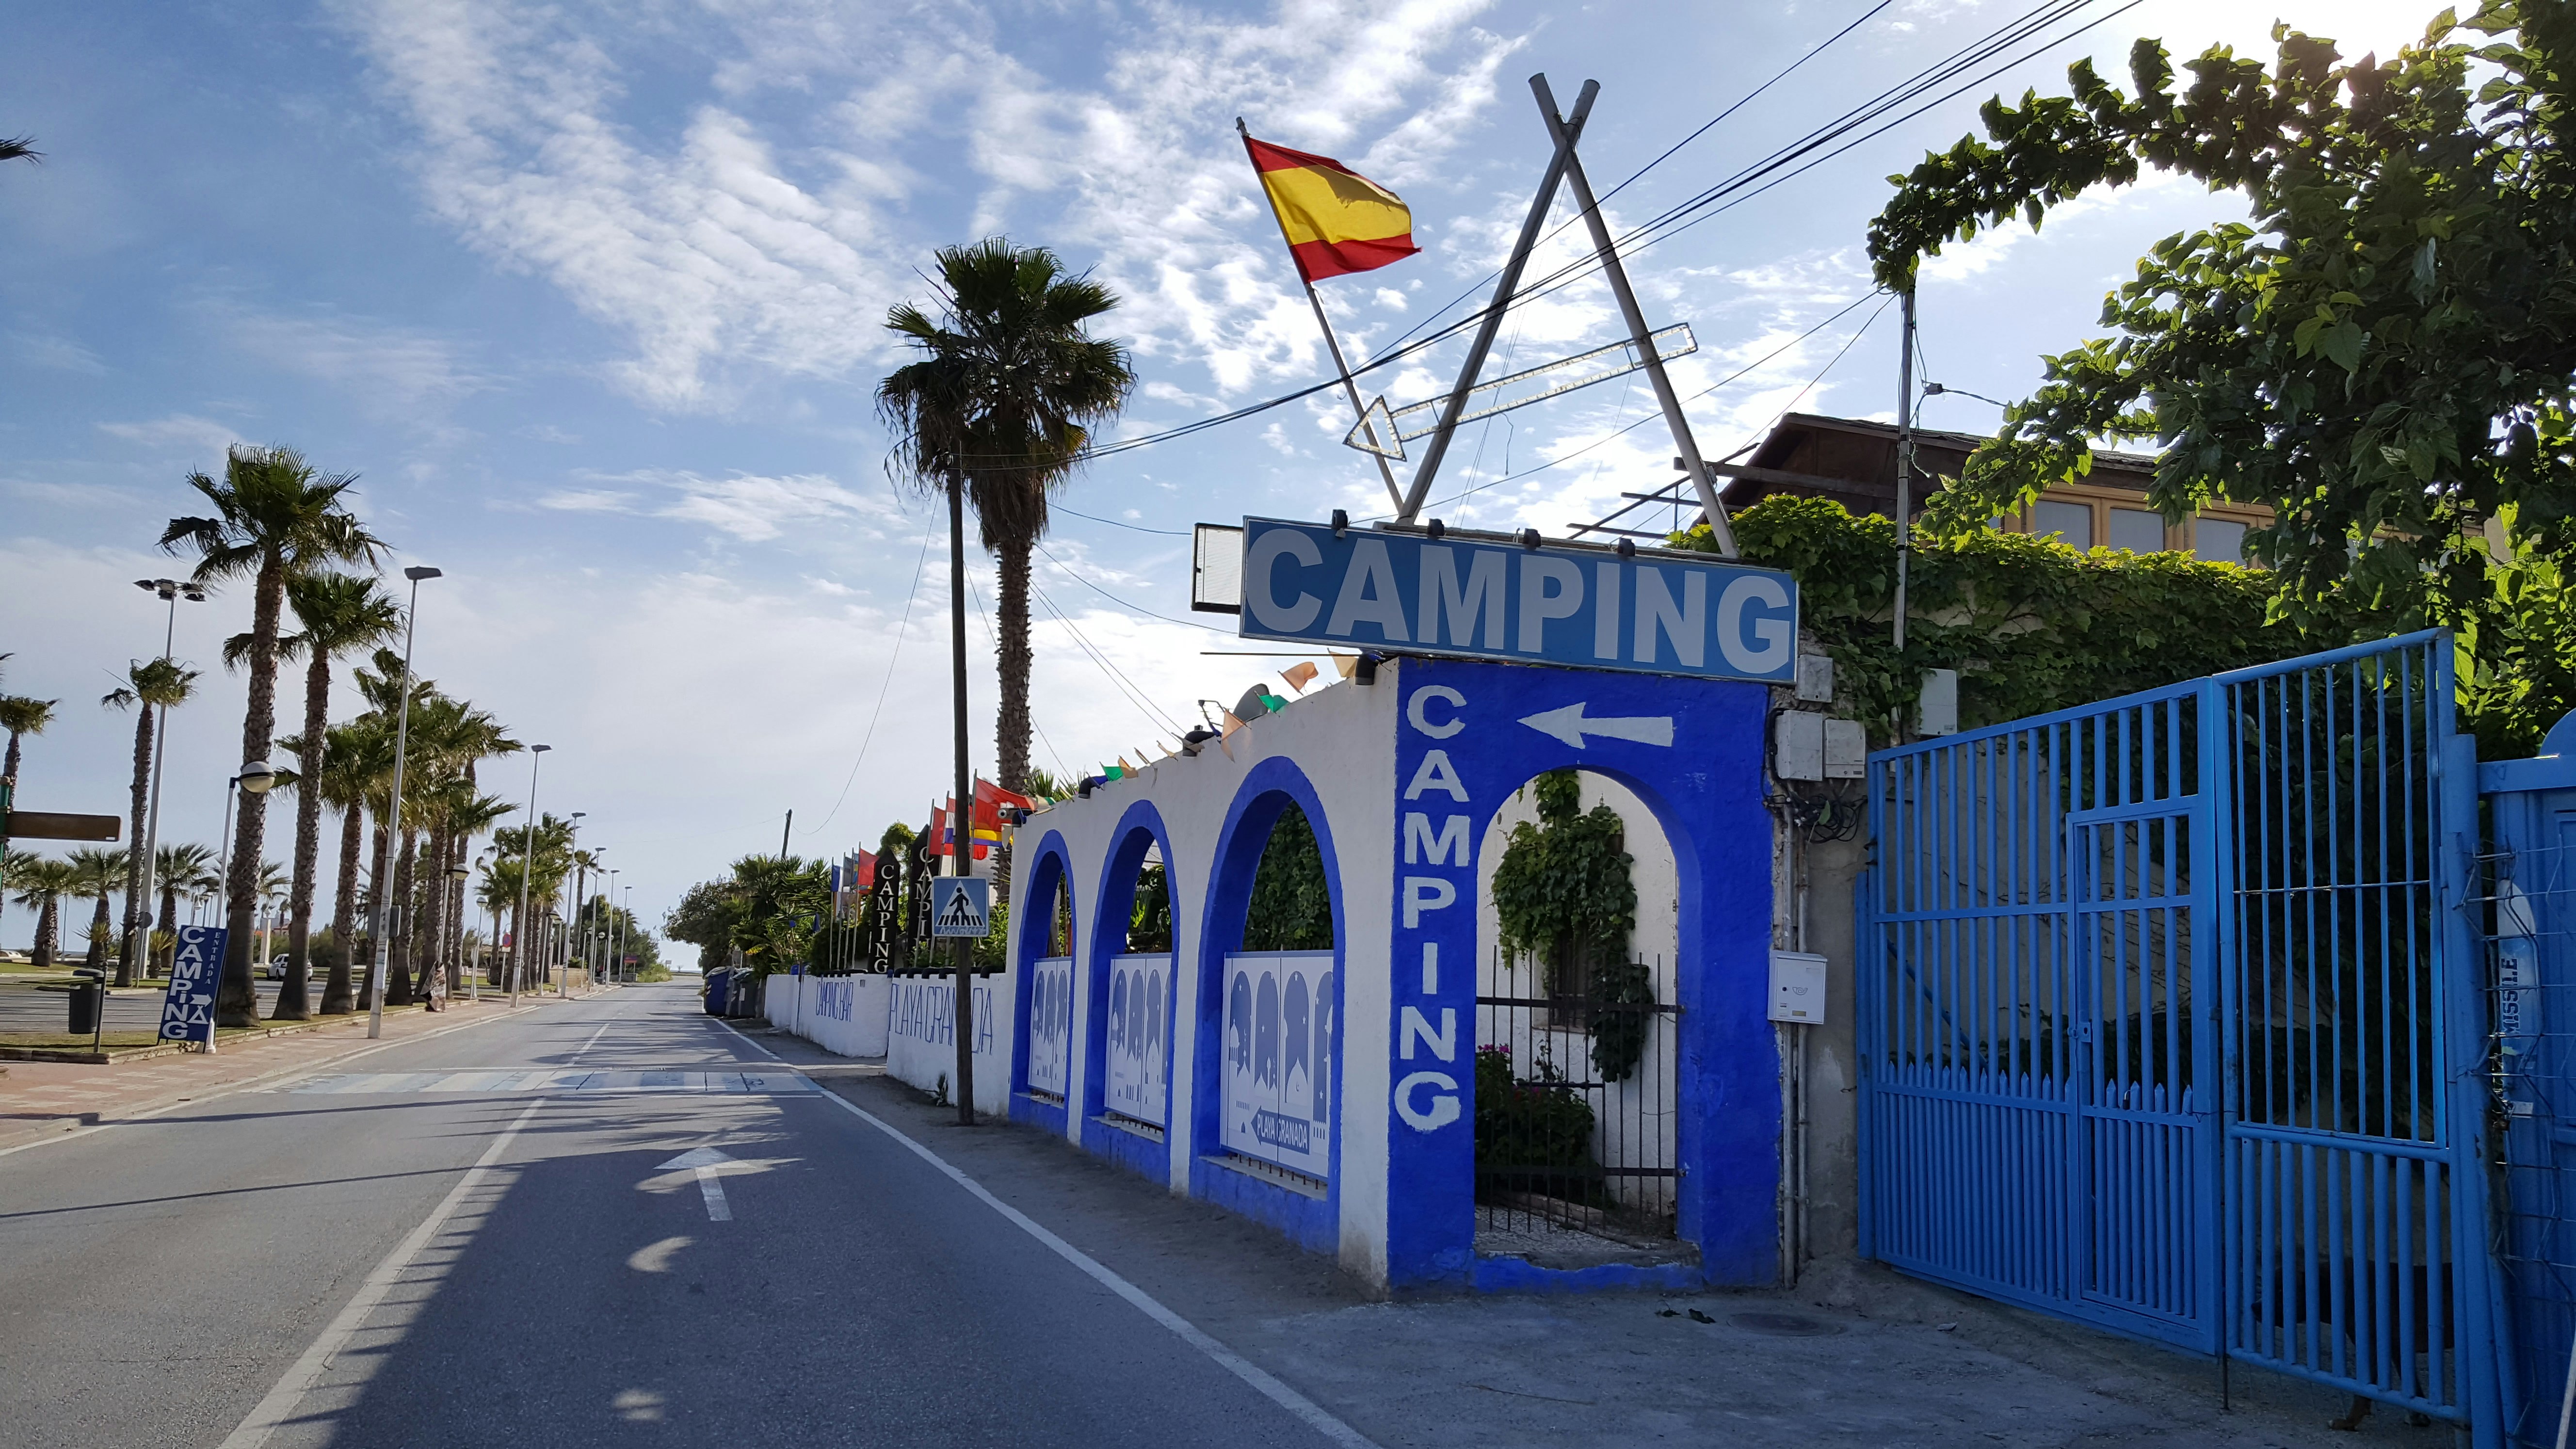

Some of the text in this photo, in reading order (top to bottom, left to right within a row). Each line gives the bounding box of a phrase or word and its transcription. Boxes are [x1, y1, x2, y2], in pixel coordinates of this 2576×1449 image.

[1246, 528, 1790, 675] CAMPING
[874, 865, 895, 974] CAMPING
[914, 846, 934, 947] CAMPI
[1395, 685, 1470, 1132] CAMPING
[205, 932, 221, 984] ENTRADA
[839, 979, 854, 1022] BAR
[888, 983, 992, 1055] PLAYA GRANDA
[1257, 1114, 1307, 1149] PLAYA GRANADA
